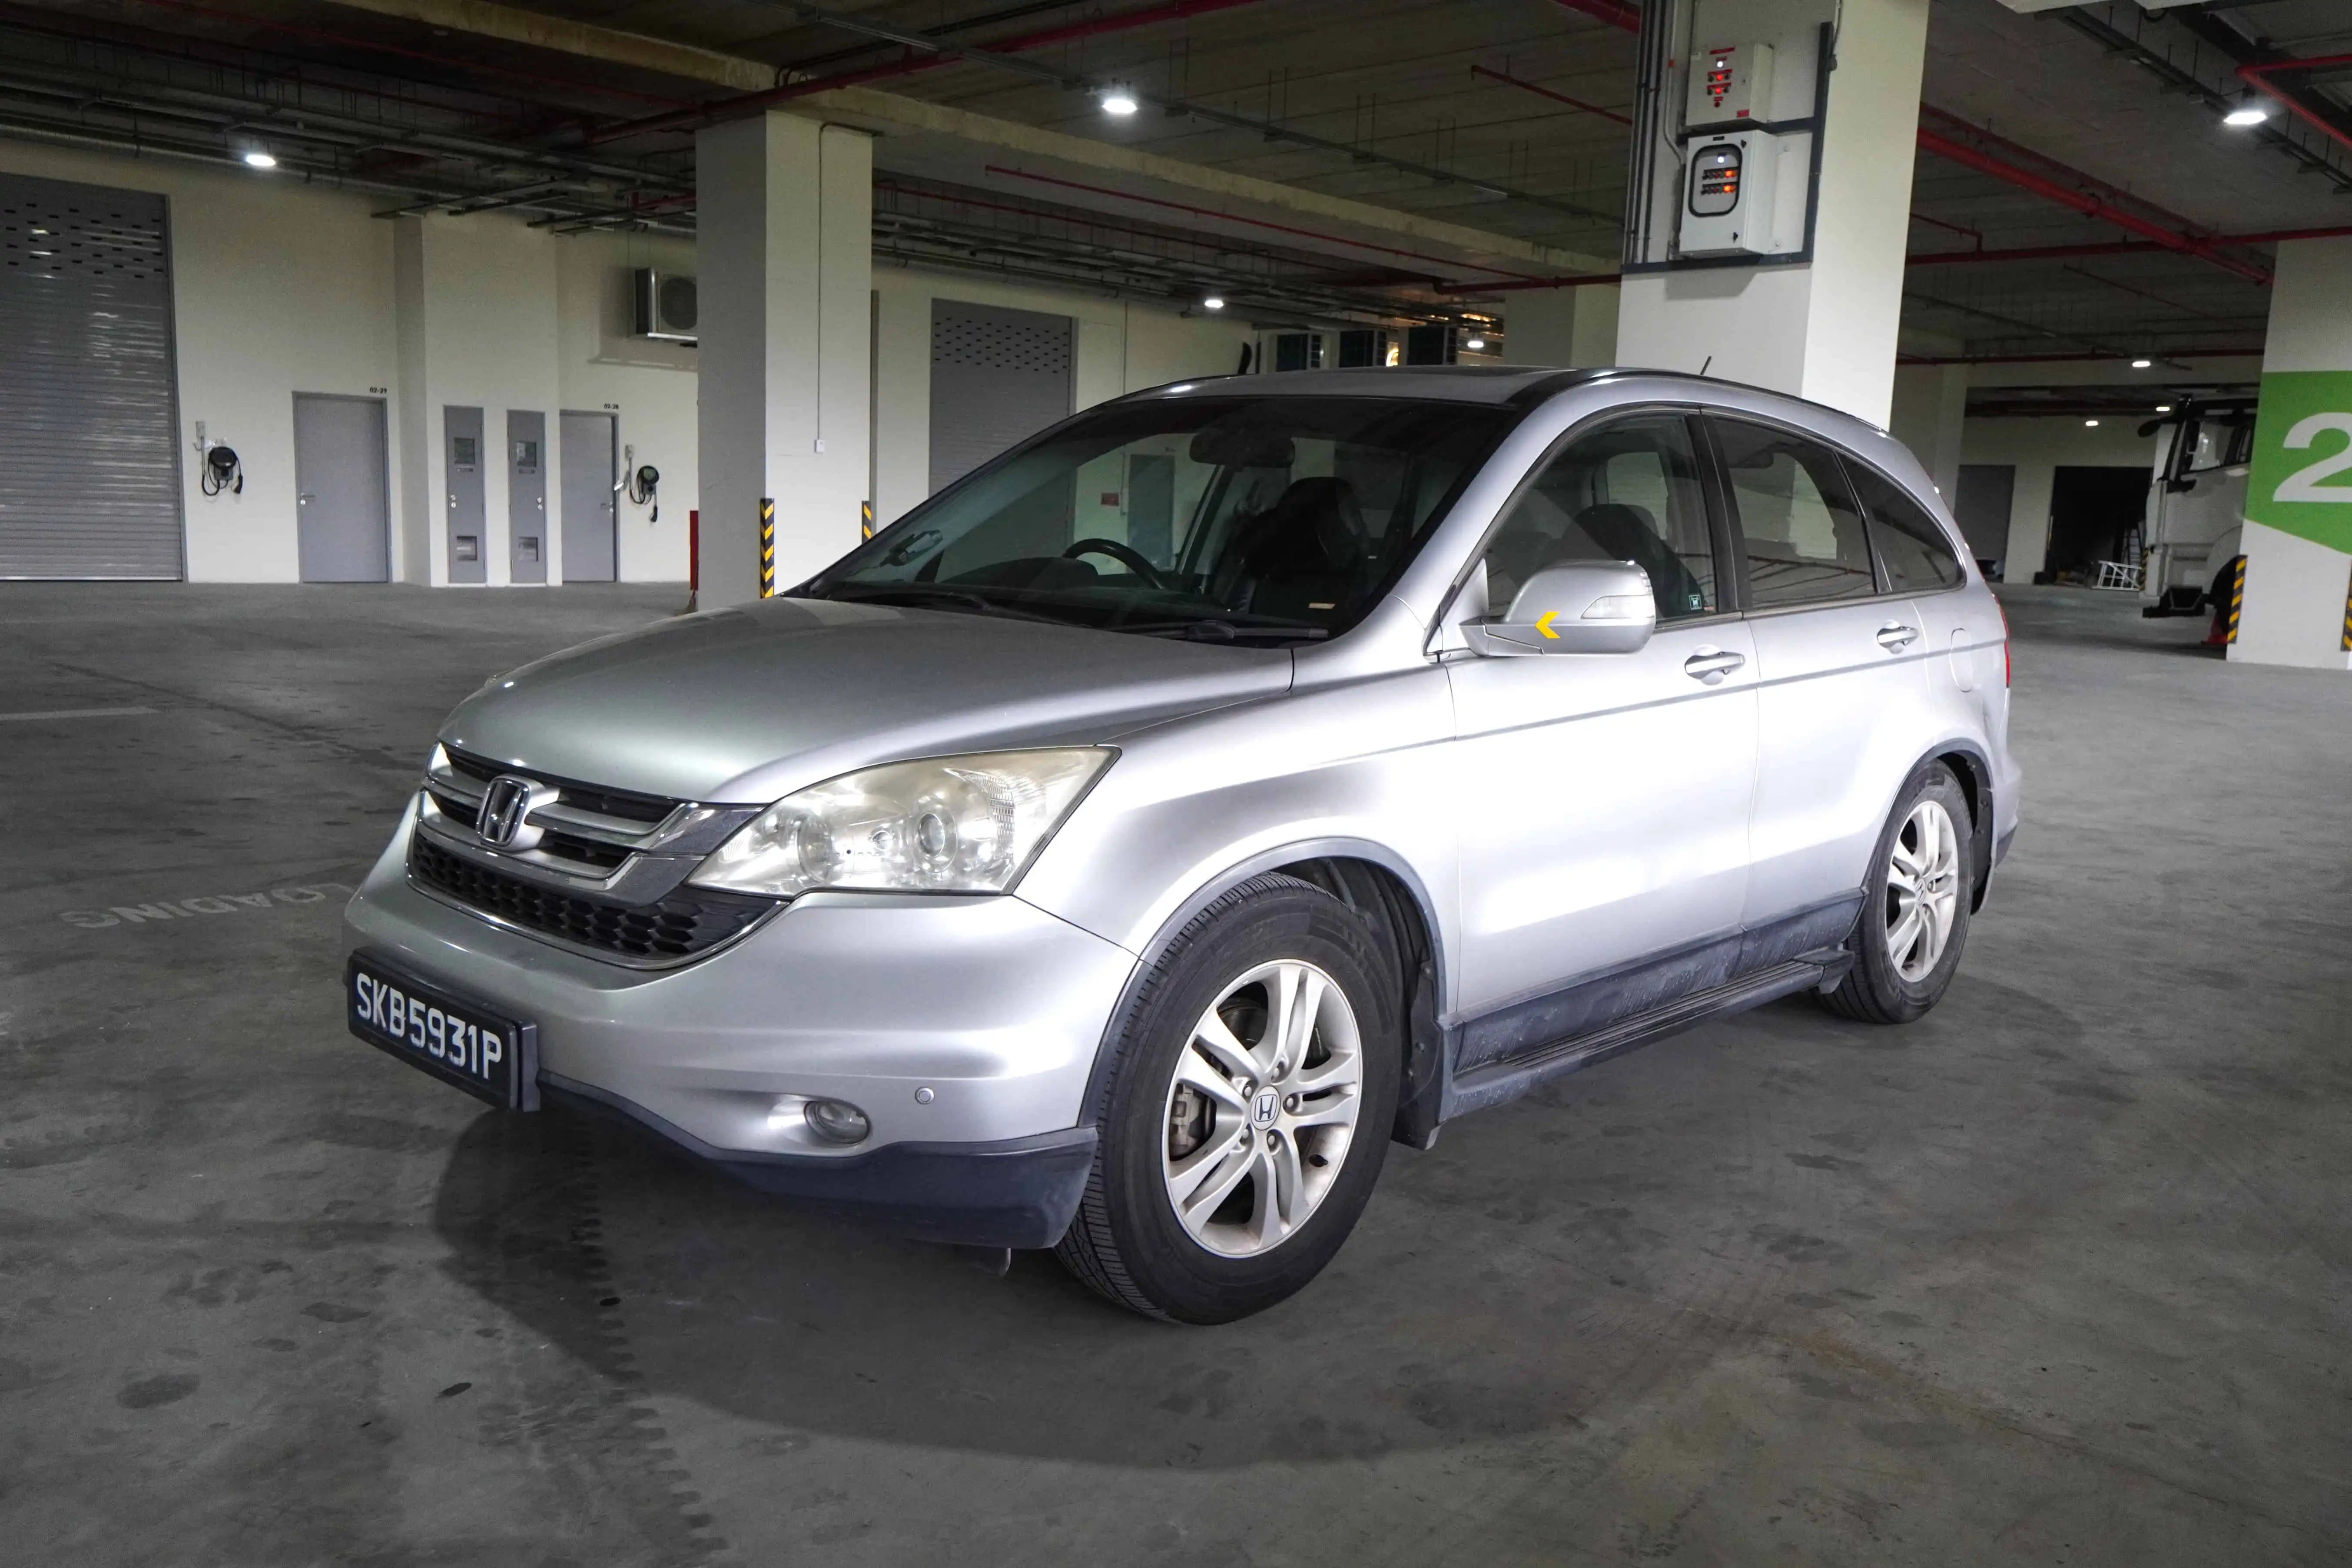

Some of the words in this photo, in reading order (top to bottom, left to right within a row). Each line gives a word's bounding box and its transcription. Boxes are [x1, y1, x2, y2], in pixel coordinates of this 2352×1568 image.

[2273, 412, 2352, 503] 2
[357, 972, 502, 1080] SKB5931P
[1258, 1096, 1274, 1120] H
